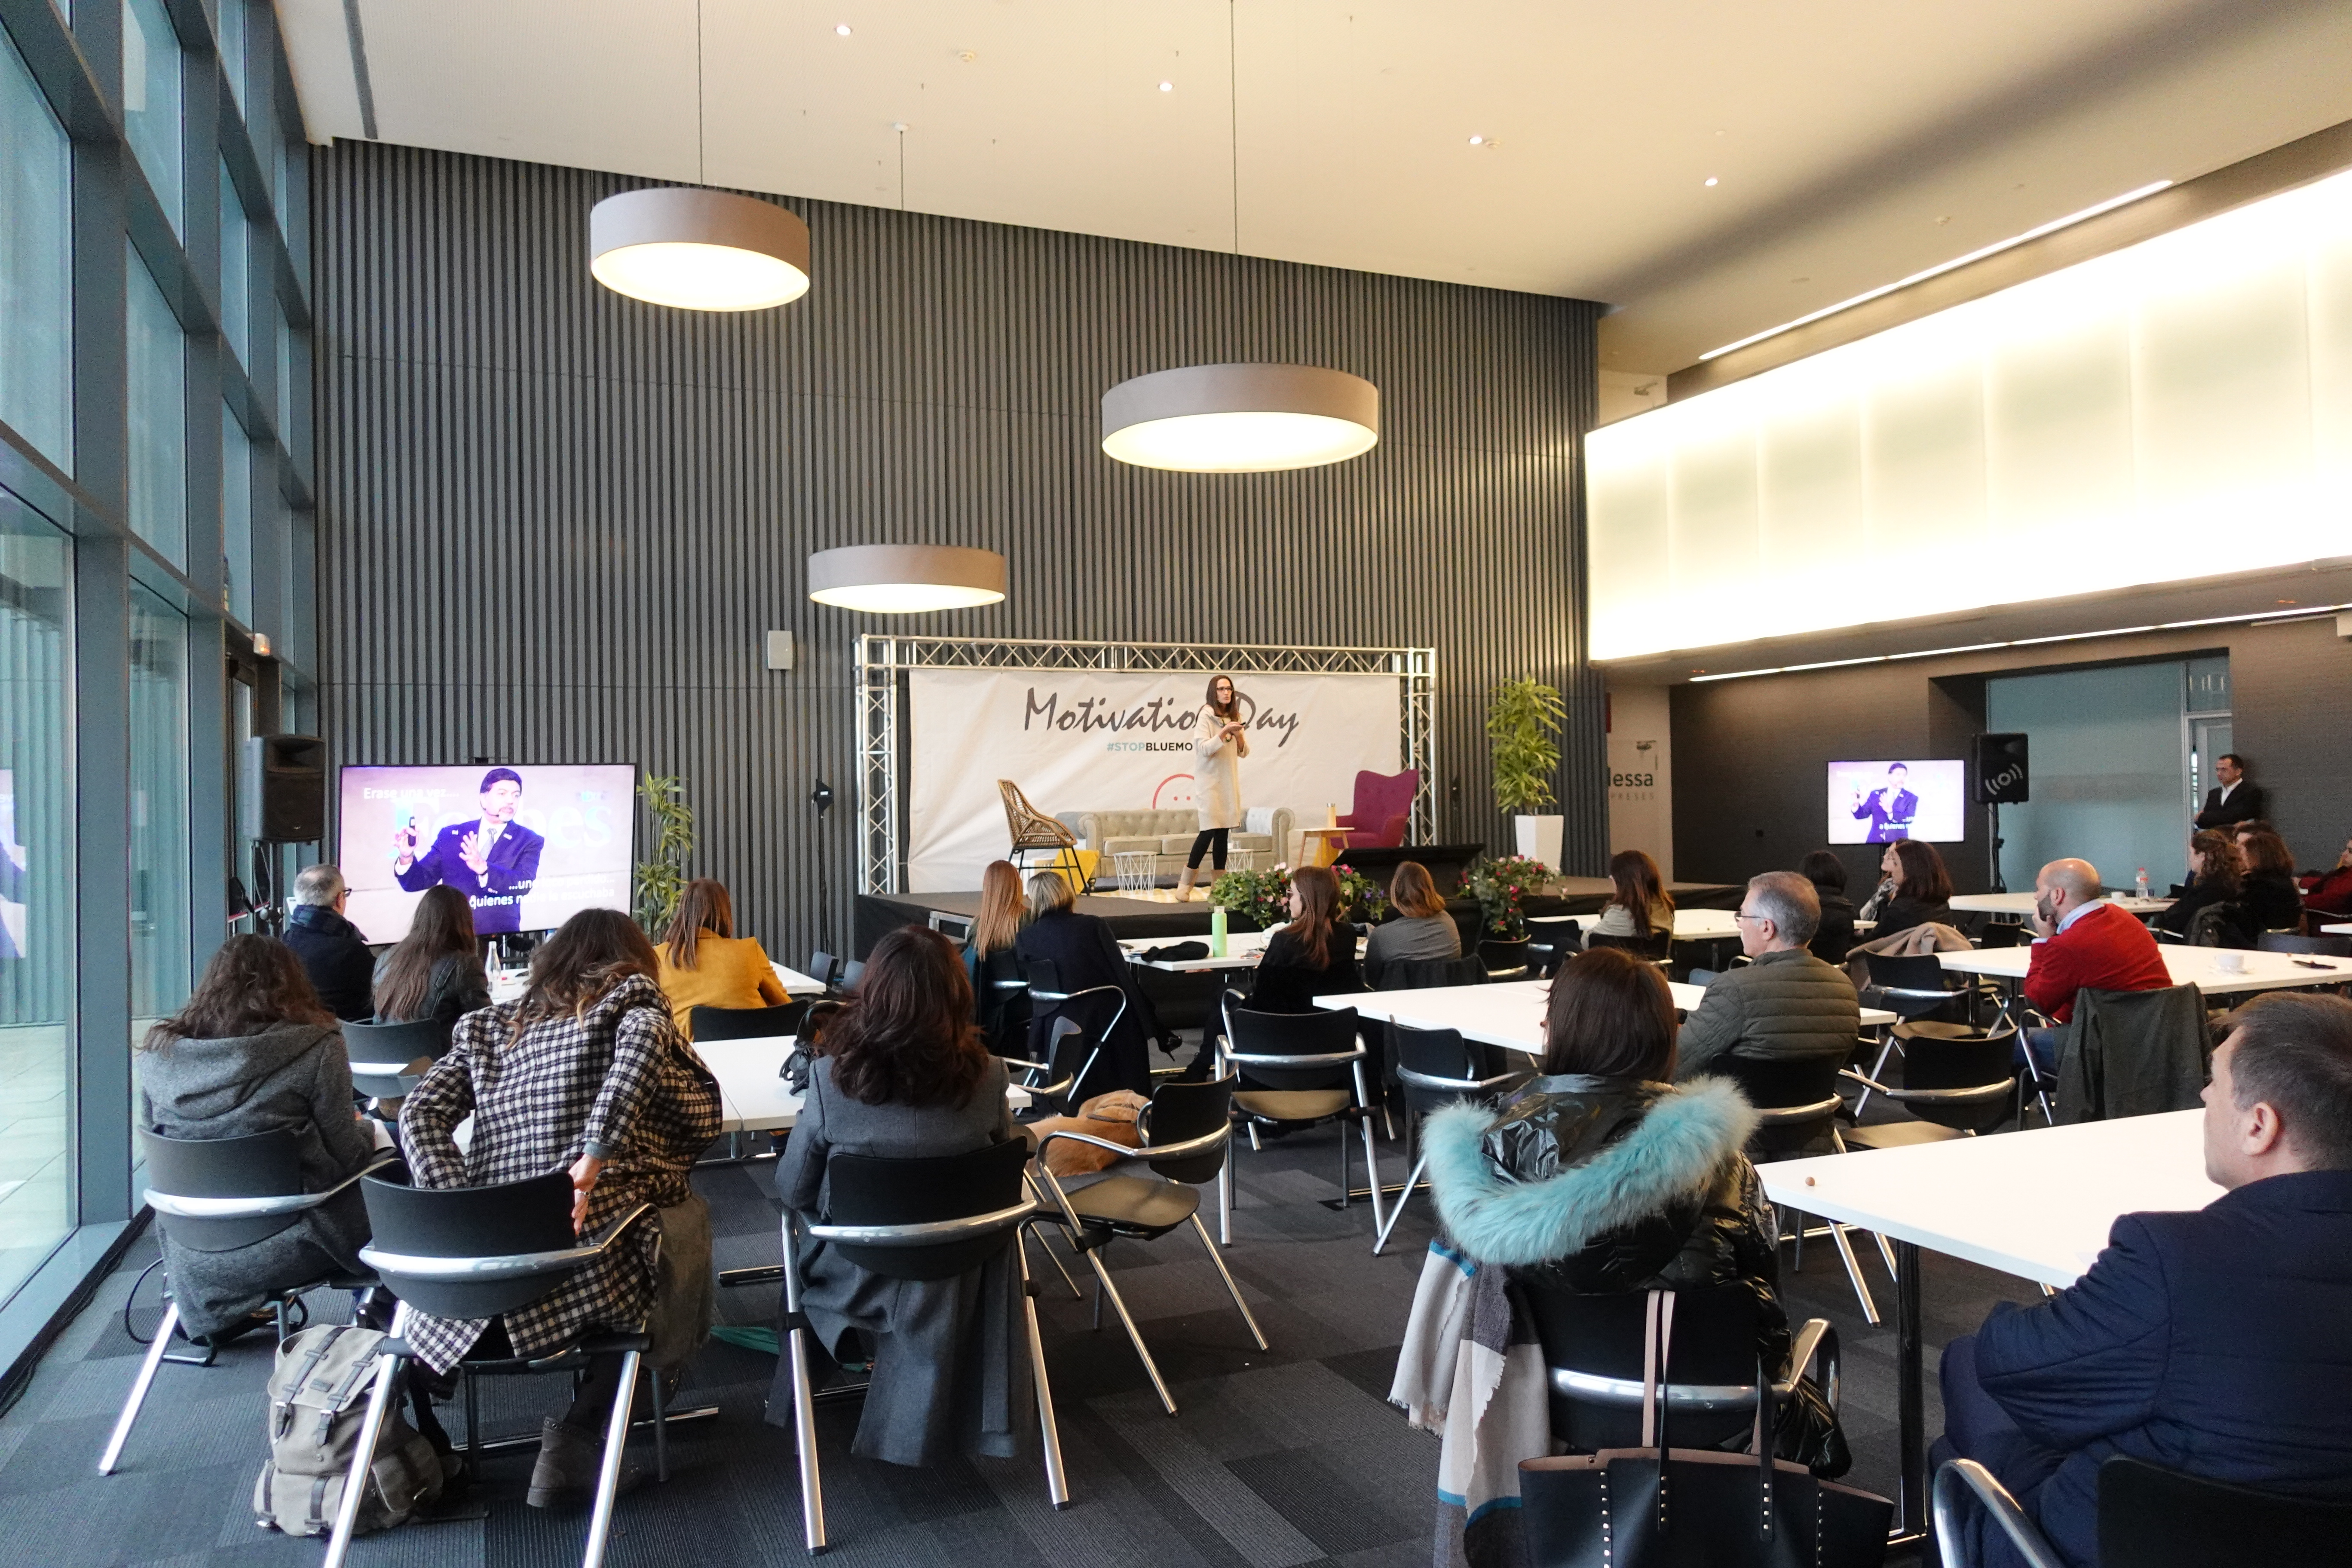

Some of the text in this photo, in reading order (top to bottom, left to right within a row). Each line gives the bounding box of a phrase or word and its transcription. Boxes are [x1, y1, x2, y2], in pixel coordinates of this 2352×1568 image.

[1024, 687, 1298, 747] Motivatio Day
[364, 787, 397, 799] Erase
[401, 789, 423, 798] una
[469, 895, 513, 910] quienes
